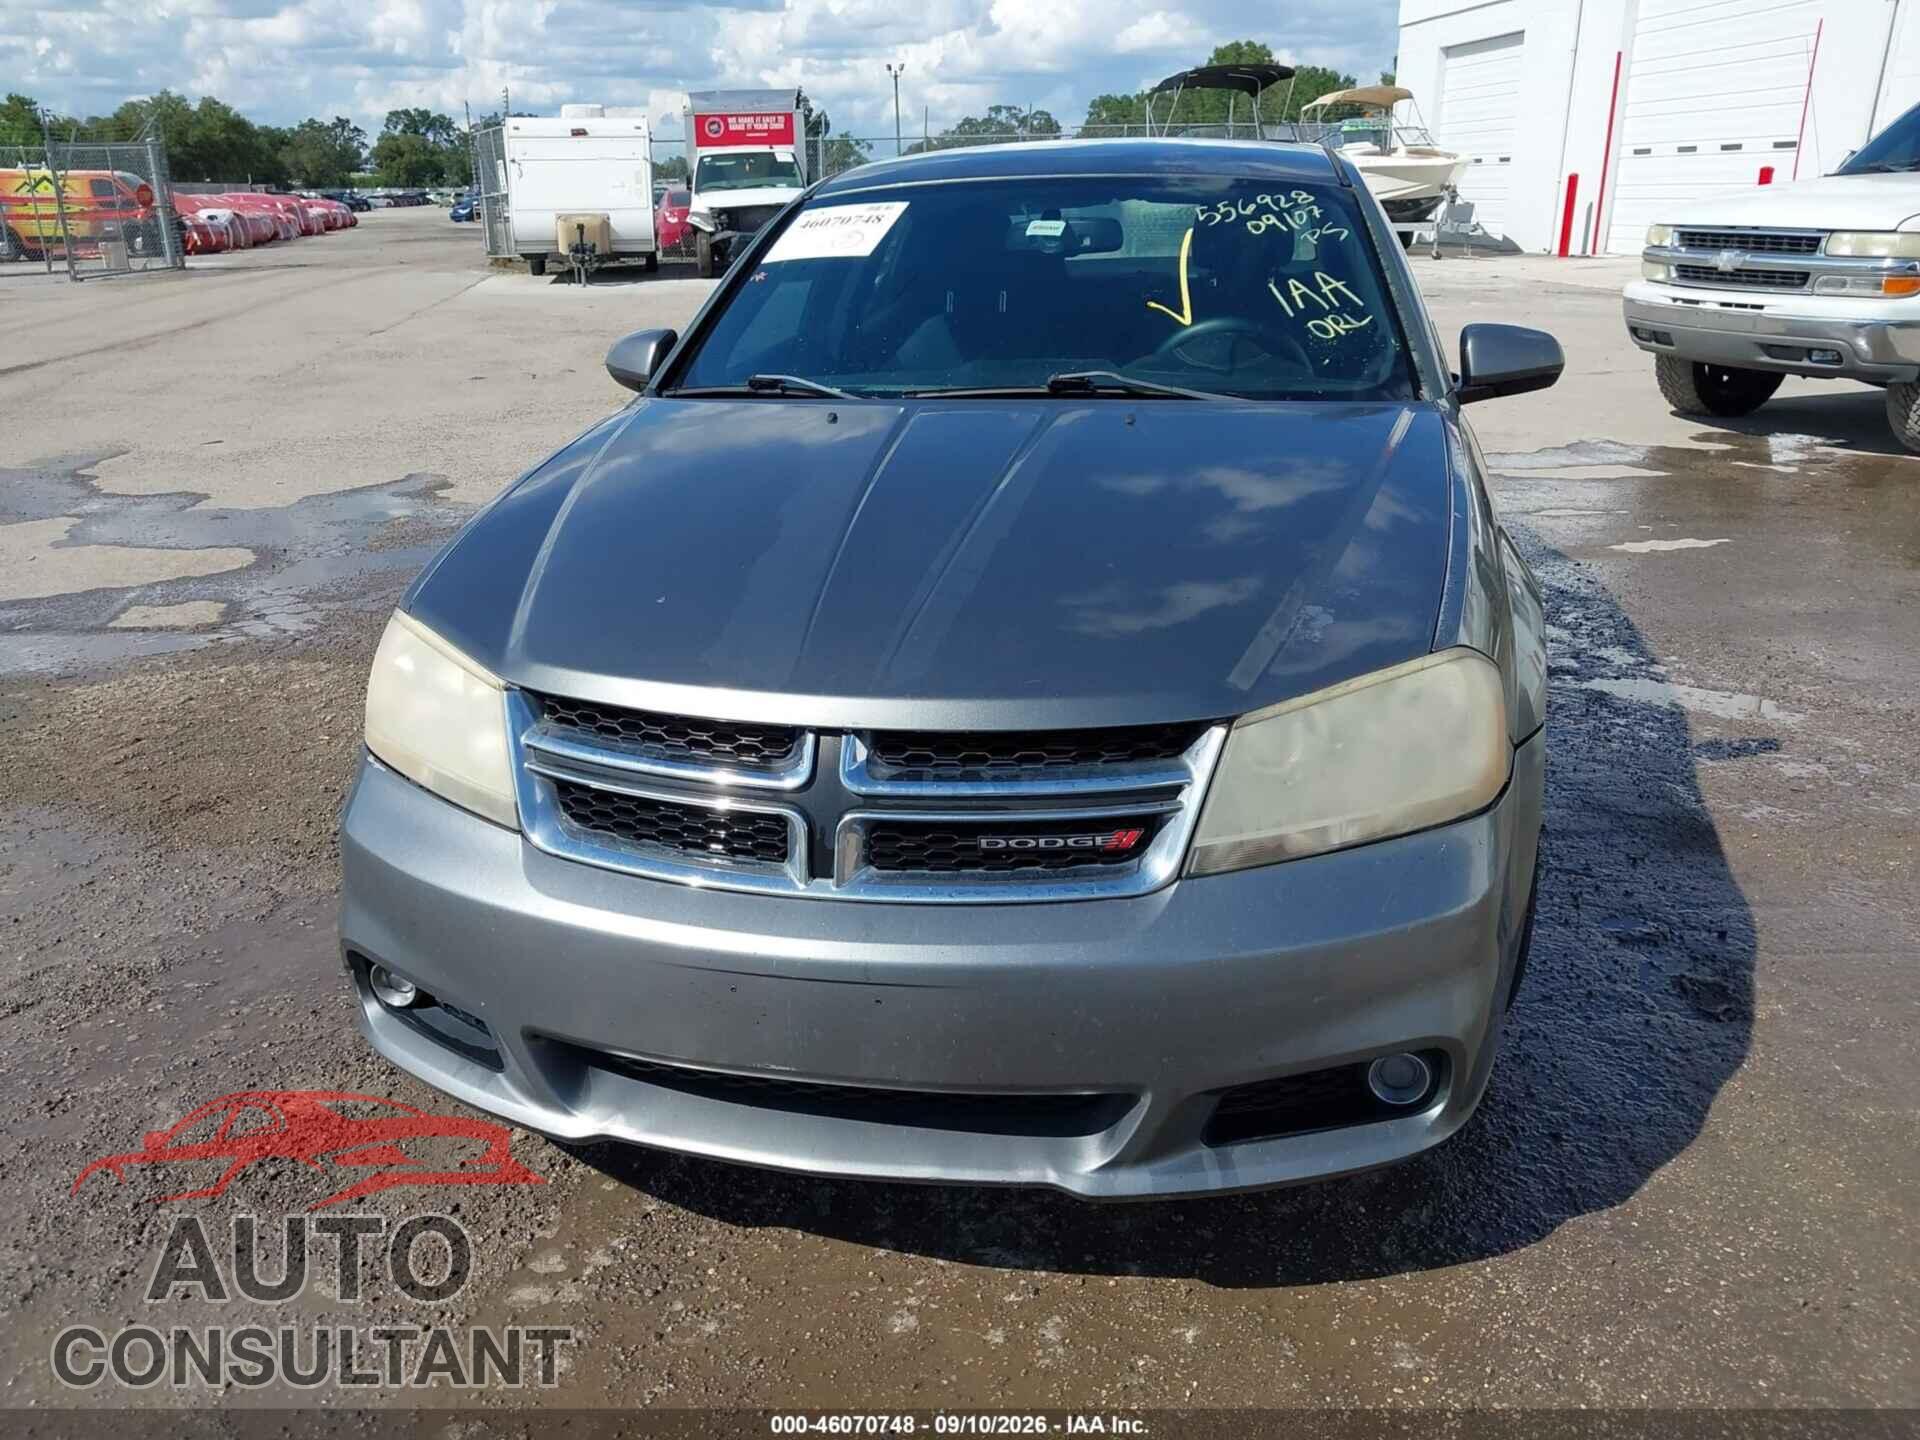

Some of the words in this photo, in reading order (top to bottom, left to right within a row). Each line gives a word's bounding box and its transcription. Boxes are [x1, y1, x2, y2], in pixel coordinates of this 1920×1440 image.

[1196, 190, 1315, 226] 556928
[800, 214, 884, 229] 46070748
[1268, 271, 1365, 318] IAA
[1307, 313, 1374, 339] ORL
[980, 836, 1120, 849] DODGE
